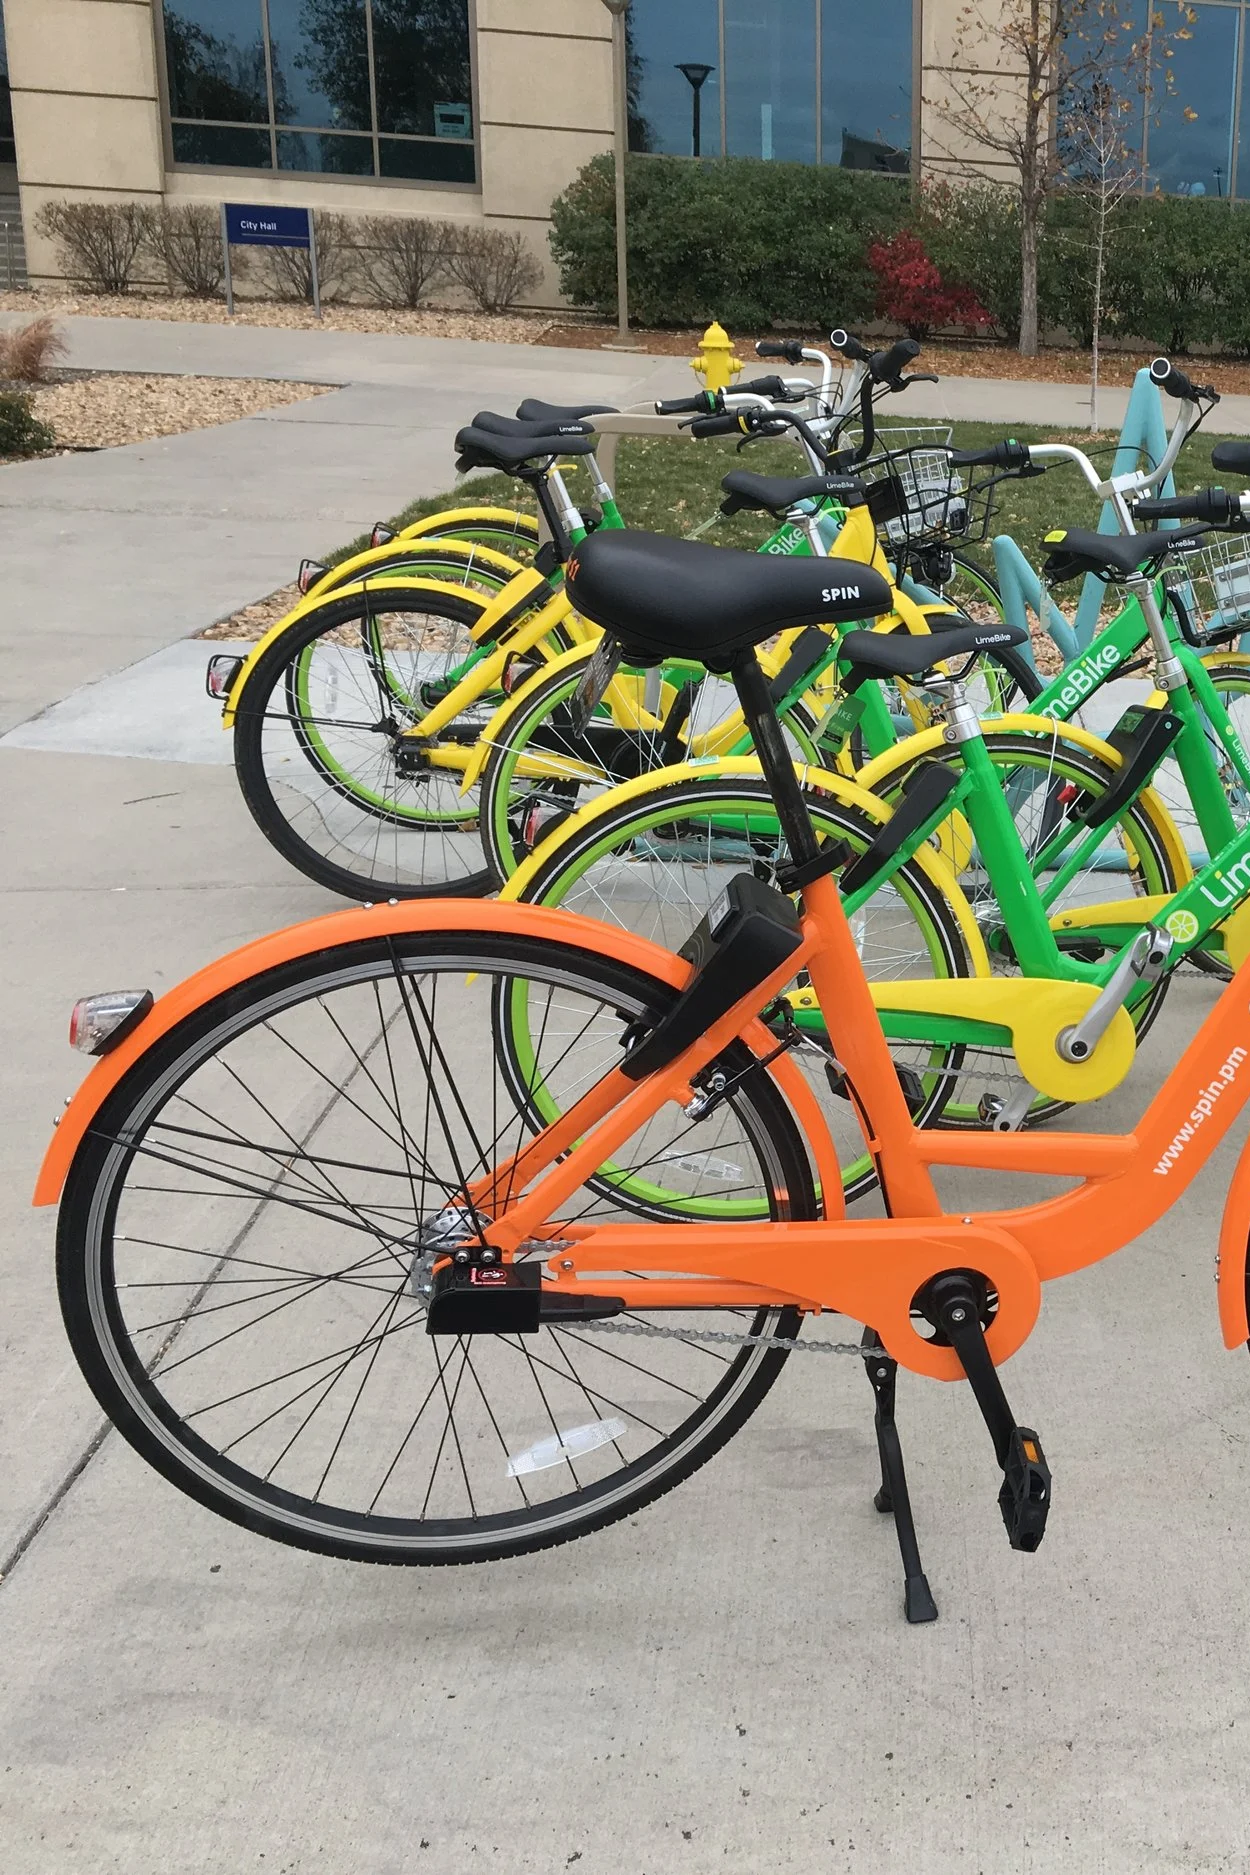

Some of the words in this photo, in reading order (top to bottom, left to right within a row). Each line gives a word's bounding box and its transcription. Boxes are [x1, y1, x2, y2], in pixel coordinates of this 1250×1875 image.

[240, 220, 258, 231] City
[260, 222, 277, 231] Hall
[826, 481, 855, 489] LimeBike
[821, 585, 860, 602] SPIN
[975, 633, 1011, 645] LimeBike
[1030, 644, 1121, 730] meBike
[1153, 1046, 1248, 1176] www.spin.pm
